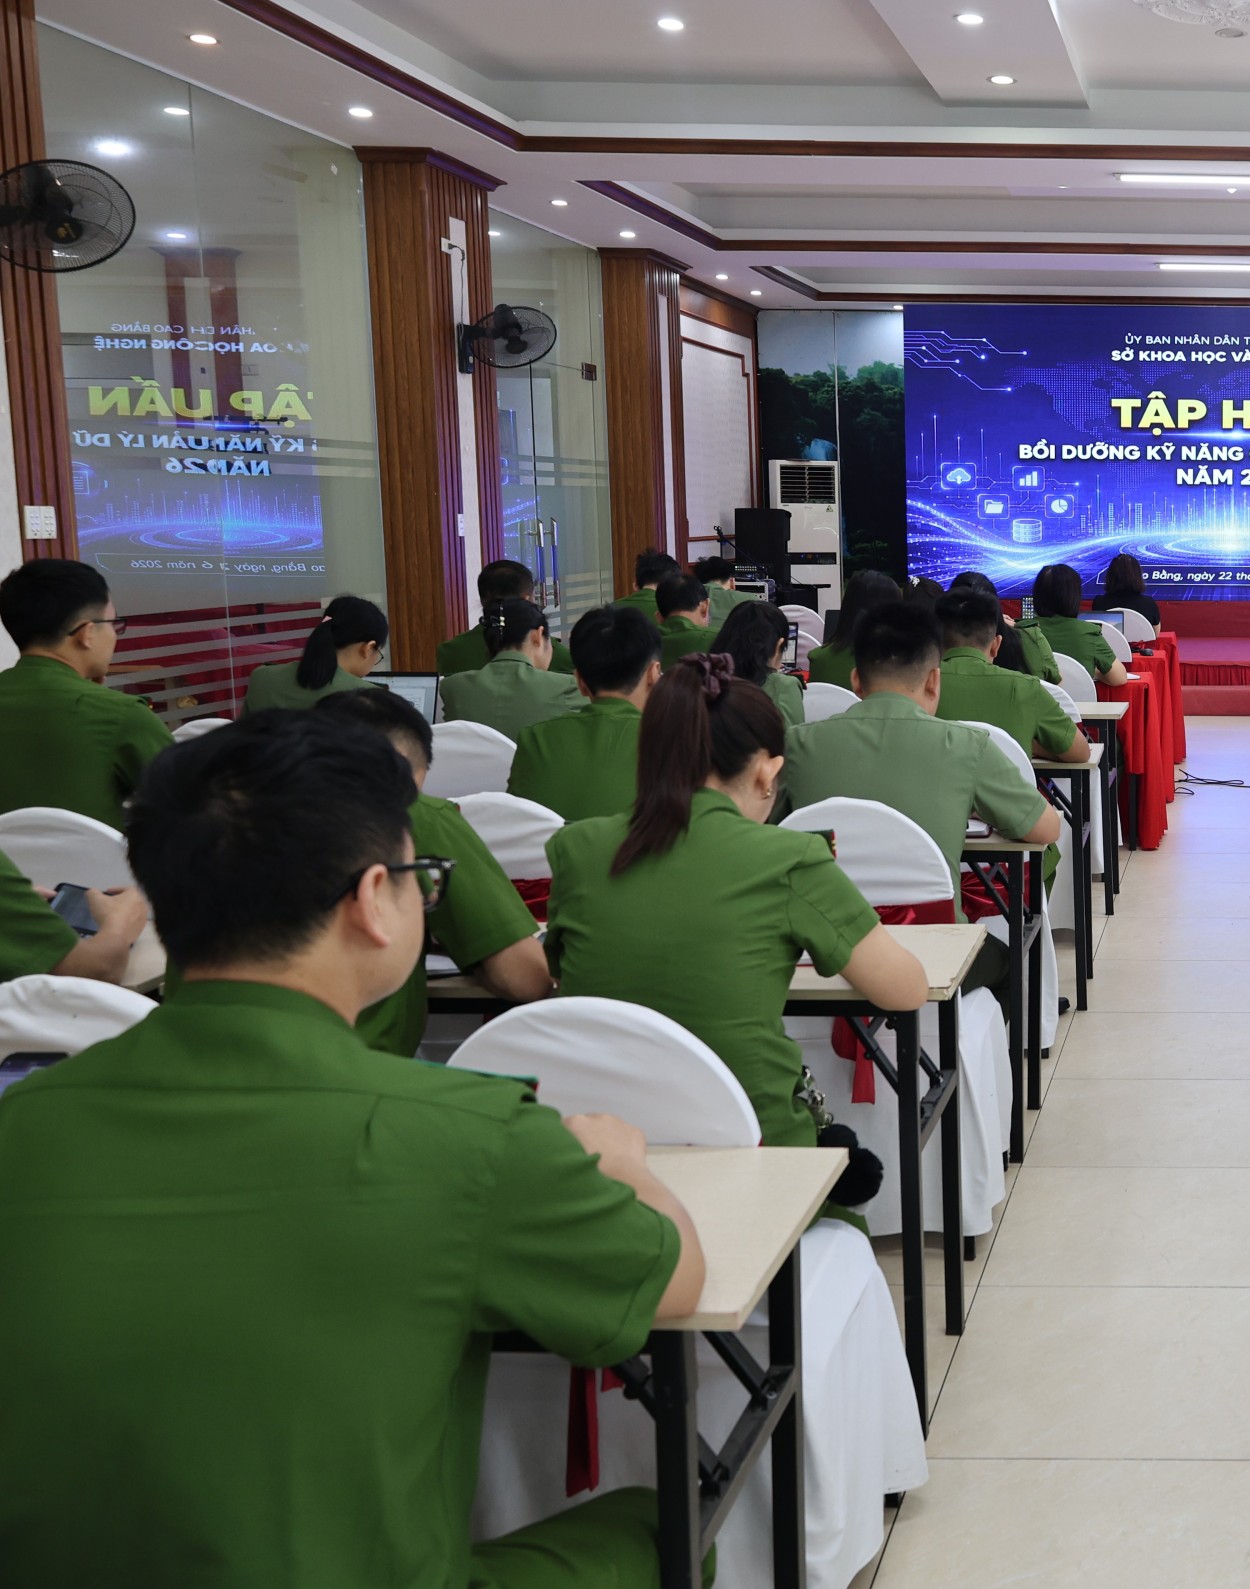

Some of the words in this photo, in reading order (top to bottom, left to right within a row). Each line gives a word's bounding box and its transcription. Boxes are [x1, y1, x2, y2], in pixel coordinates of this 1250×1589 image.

[1125, 333, 1142, 344] ỦY
[1146, 336, 1172, 345] BAN
[1175, 334, 1210, 345] NHÂN
[1214, 334, 1240, 345] DÂN
[1111, 347, 1135, 362] SỞ
[1139, 350, 1187, 362] KHOA
[1191, 350, 1227, 365] HỌC
[1111, 391, 1207, 436] TẬP
[1019, 439, 1055, 460] BỒI
[1062, 441, 1140, 461] DƯỠNG
[1147, 442, 1176, 461] KỸ
[1181, 442, 1244, 461] NĂNG
[1176, 465, 1233, 485] NĂM
[1152, 569, 1183, 582] Bằng,
[1187, 572, 1215, 583] ngày
[1218, 571, 1232, 580] 22
